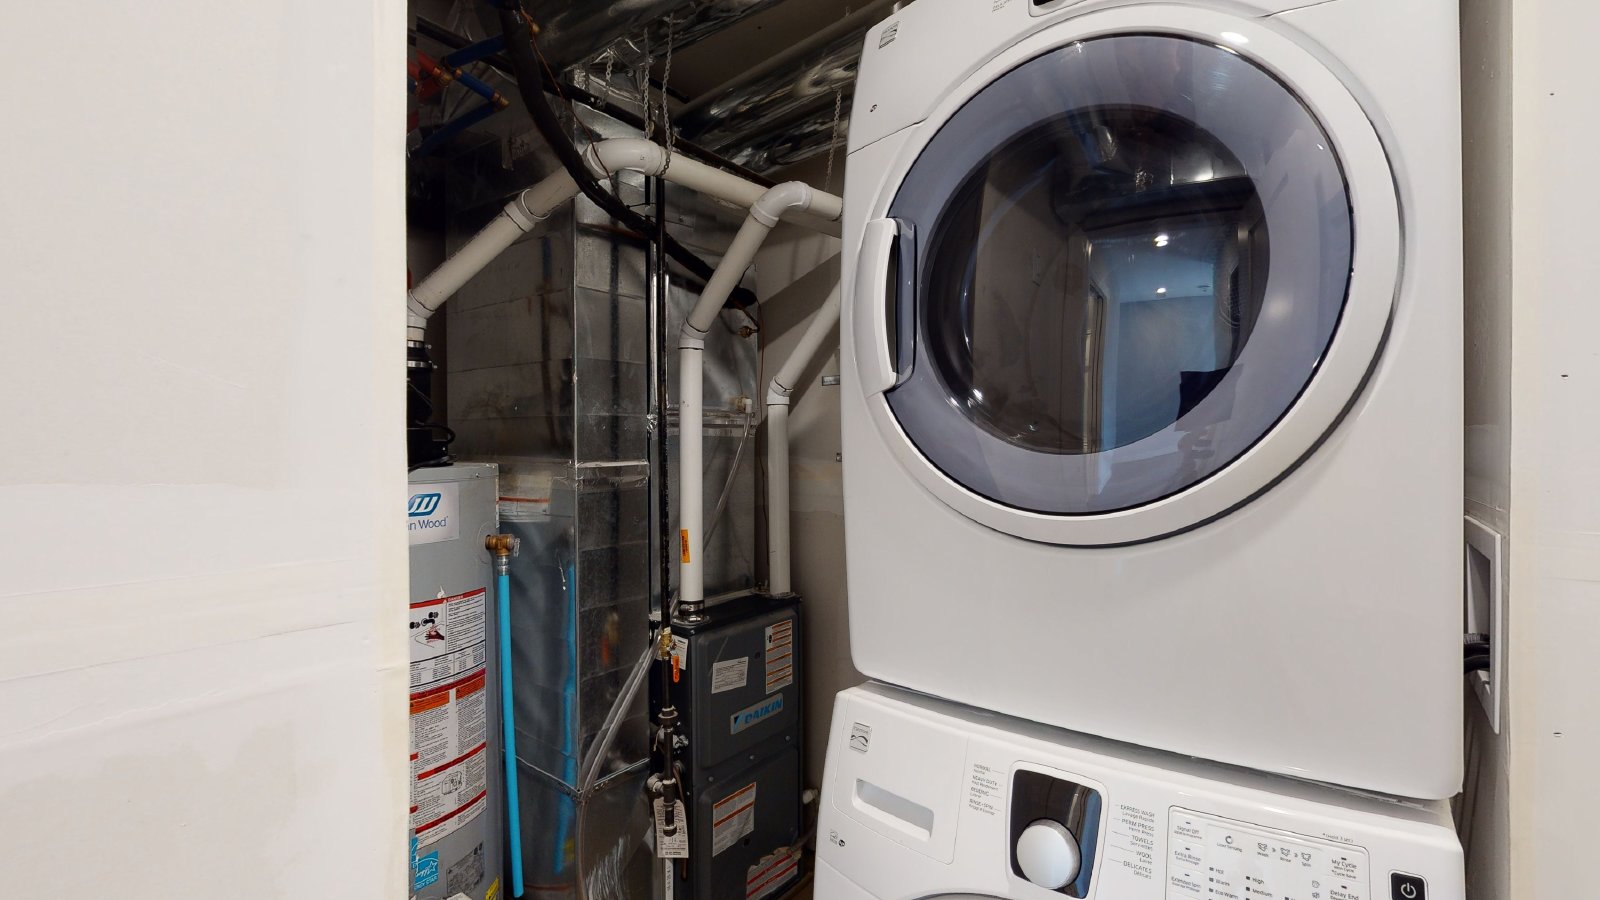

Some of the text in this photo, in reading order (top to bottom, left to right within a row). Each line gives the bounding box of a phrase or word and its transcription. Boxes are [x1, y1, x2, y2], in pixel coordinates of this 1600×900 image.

[418, 516, 447, 529] Wood
[745, 698, 783, 724] DAIKIN
[1141, 810, 1155, 818] WASH
[1121, 818, 1155, 832] PERM PRESS
[1131, 834, 1154, 846] TOWELS
[1136, 851, 1153, 860] WOOL
[1123, 860, 1152, 874] DELICATES
[1341, 861, 1358, 870] Cycle
[1252, 877, 1265, 885] High
[1223, 892, 1239, 900] Warm
[1252, 888, 1273, 898] Medium
[1329, 889, 1347, 899] Delay
